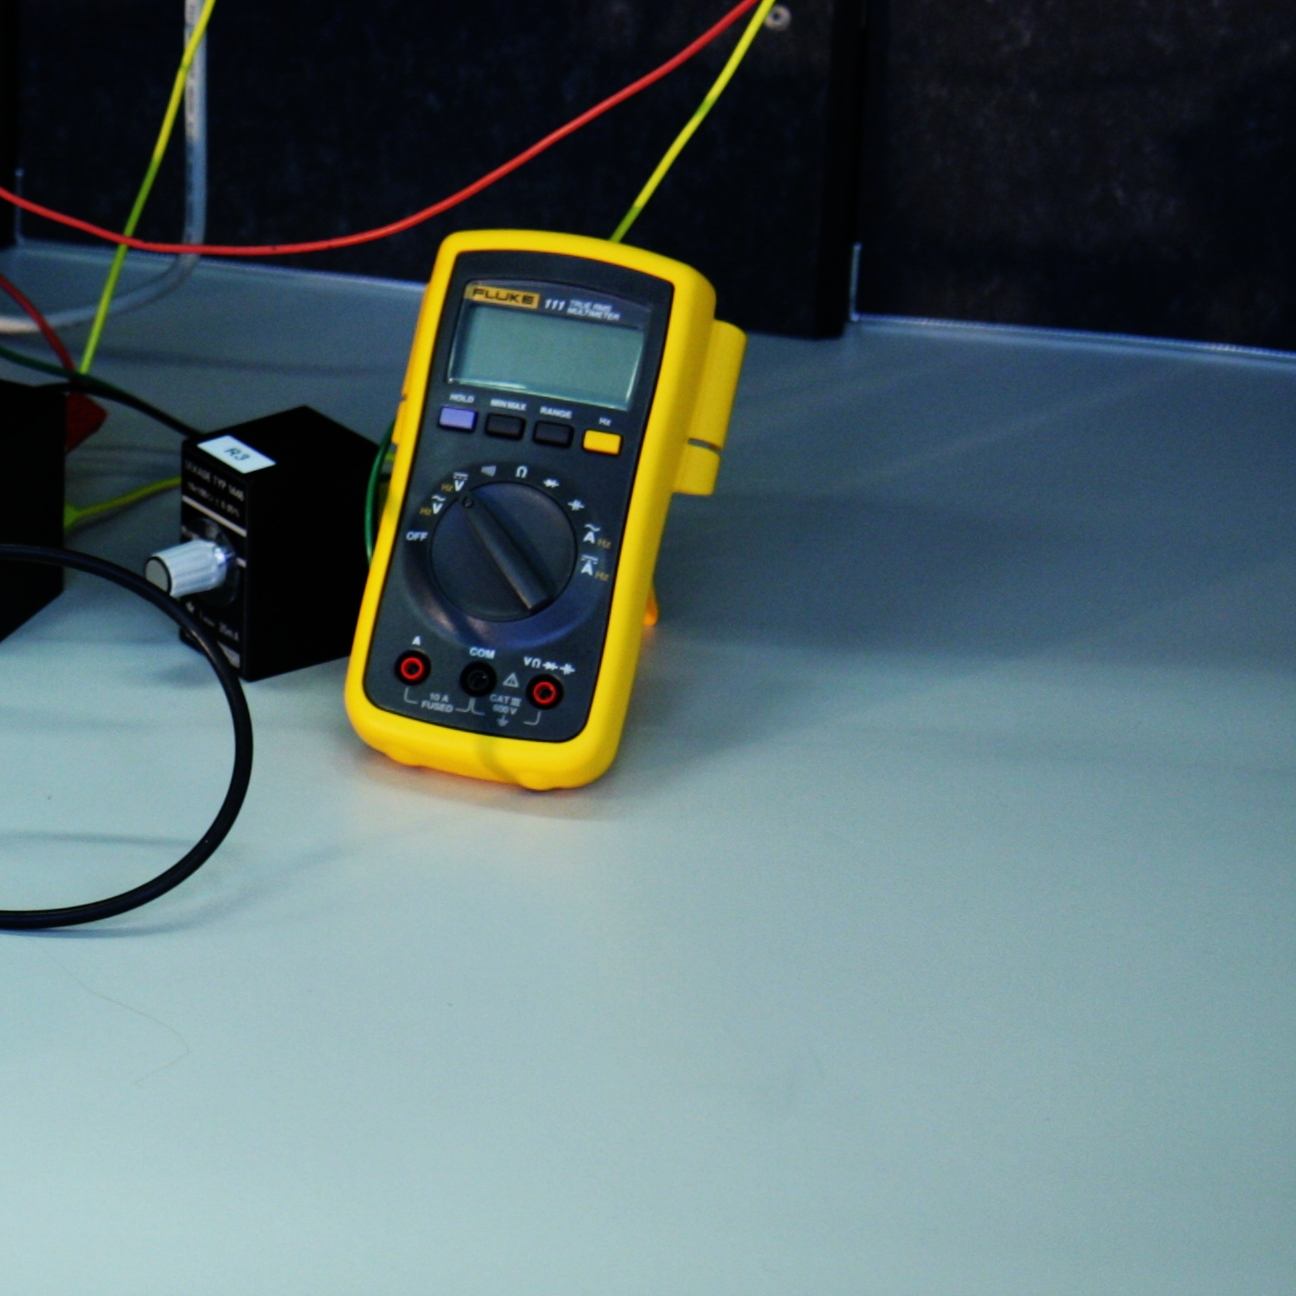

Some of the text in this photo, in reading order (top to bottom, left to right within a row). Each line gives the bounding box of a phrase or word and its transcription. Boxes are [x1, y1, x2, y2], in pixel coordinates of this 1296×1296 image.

[471, 288, 567, 312] FLUKE 111
[448, 391, 476, 404] HOLD
[538, 404, 574, 420] RANGE
[405, 530, 429, 542] OFF
[411, 634, 422, 647] A
[468, 645, 497, 661] COM
[420, 699, 454, 715] FUSED
